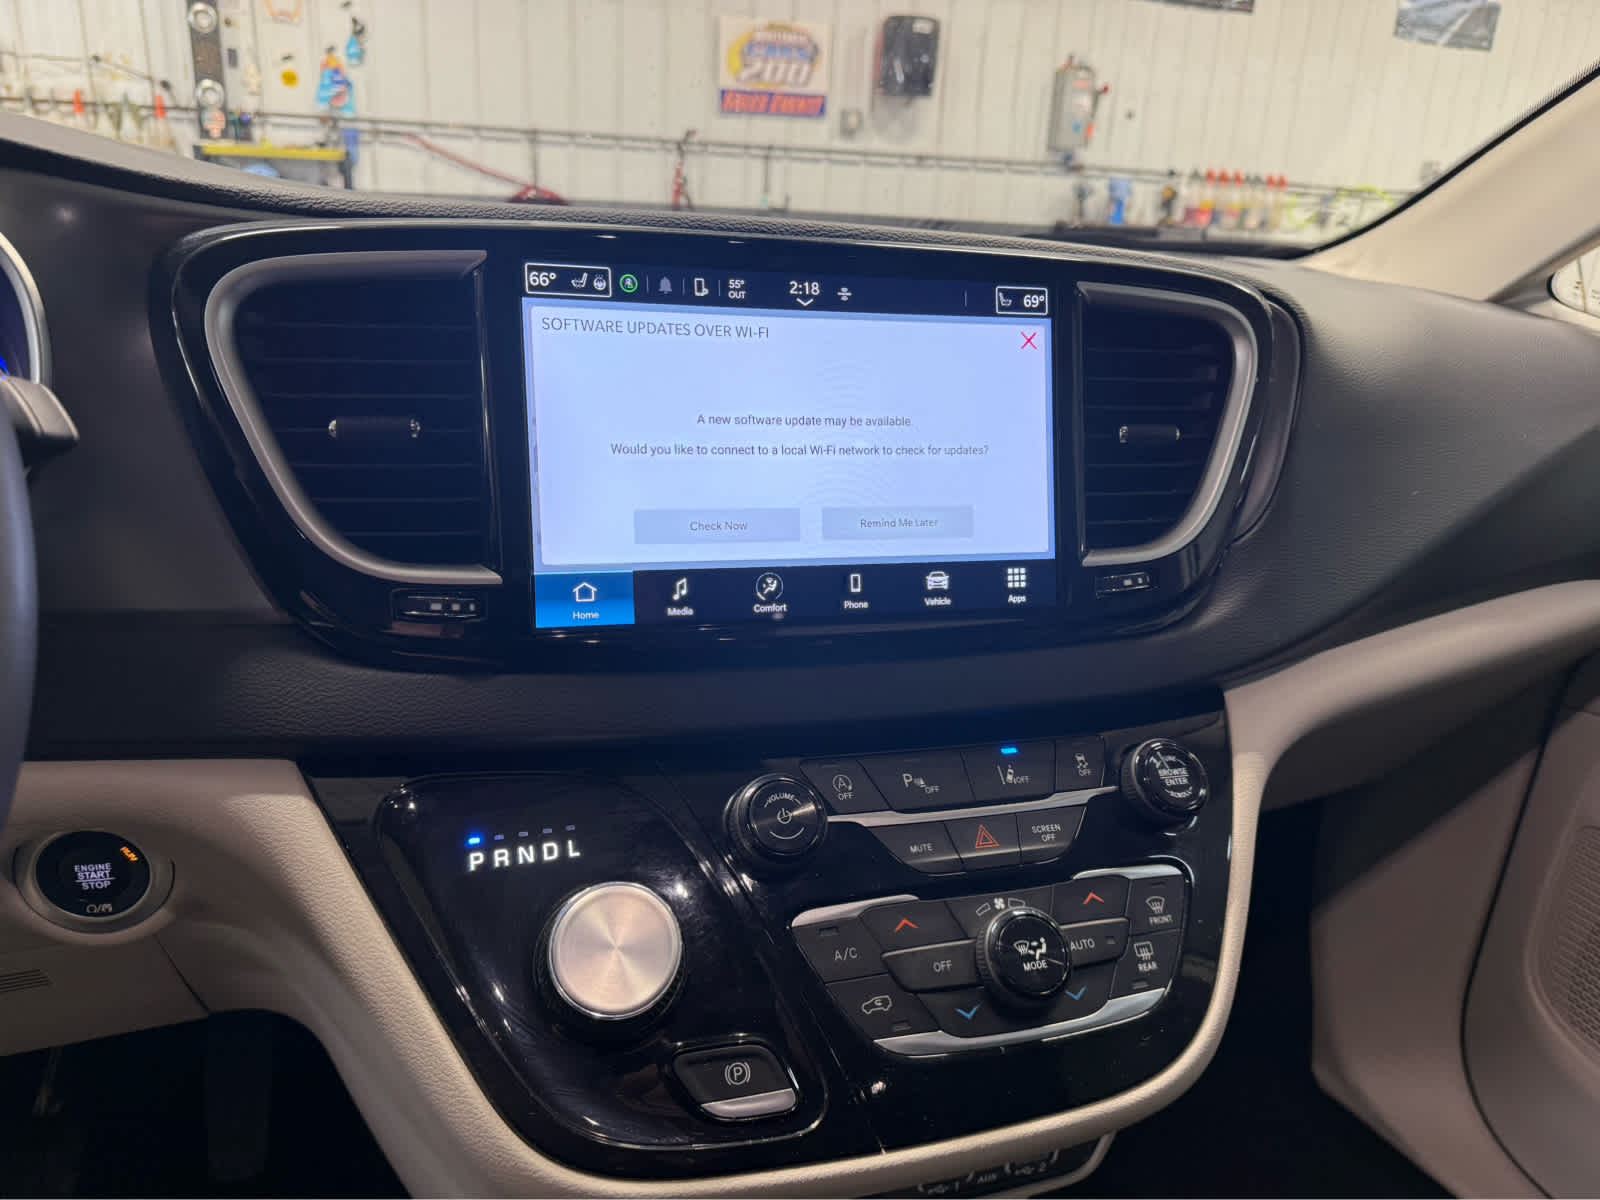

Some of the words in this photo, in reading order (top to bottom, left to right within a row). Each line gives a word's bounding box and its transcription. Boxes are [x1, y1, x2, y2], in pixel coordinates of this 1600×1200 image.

[789, 281, 820, 295] 2:18
[728, 290, 746, 299] OUT
[541, 316, 623, 333] SOFTWARE
[627, 320, 690, 336] UPDATES
[694, 323, 732, 338] OVER
[735, 325, 769, 339] WI-FI
[696, 414, 706, 425] A
[708, 415, 731, 425] new
[734, 414, 782, 426] software
[785, 415, 822, 428] update
[825, 417, 847, 429] may
[850, 416, 863, 427] be
[611, 443, 648, 455] Would
[651, 446, 671, 458] you
[674, 443, 694, 455] like
[697, 445, 708, 455] to
[711, 445, 755, 456] connect
[758, 445, 769, 456] to
[781, 444, 807, 456] local
[810, 444, 836, 456] Wi-Fi
[839, 444, 880, 456] network
[882, 445, 893, 456] to
[895, 444, 925, 456] check
[927, 444, 942, 456] for
[944, 445, 989, 458] updates?
[689, 520, 722, 532] Check
[724, 520, 748, 531] Now
[860, 518, 896, 528] Remind
[898, 518, 913, 528] Me
[915, 517, 938, 528] Later
[844, 600, 869, 610] Phone
[924, 597, 951, 606] Vehicle
[1007, 594, 1026, 605] Apps
[667, 606, 694, 616] Media
[753, 603, 787, 614] Comfort
[572, 610, 600, 620] Home
[925, 785, 940, 794] OFF
[766, 792, 796, 804] VOLUME
[838, 793, 854, 801] OFF
[1032, 823, 1061, 833] SCREEN
[1041, 833, 1056, 842] OFF
[910, 843, 933, 853] MUTE
[74, 862, 112, 873] ENGINE
[77, 870, 111, 880] START
[81, 880, 111, 890] STOP
[1070, 938, 1095, 951] AUTO
[834, 947, 858, 961] A/C
[932, 959, 952, 973] OFF
[1023, 960, 1048, 972] MODE
[1138, 961, 1158, 972] REAR
